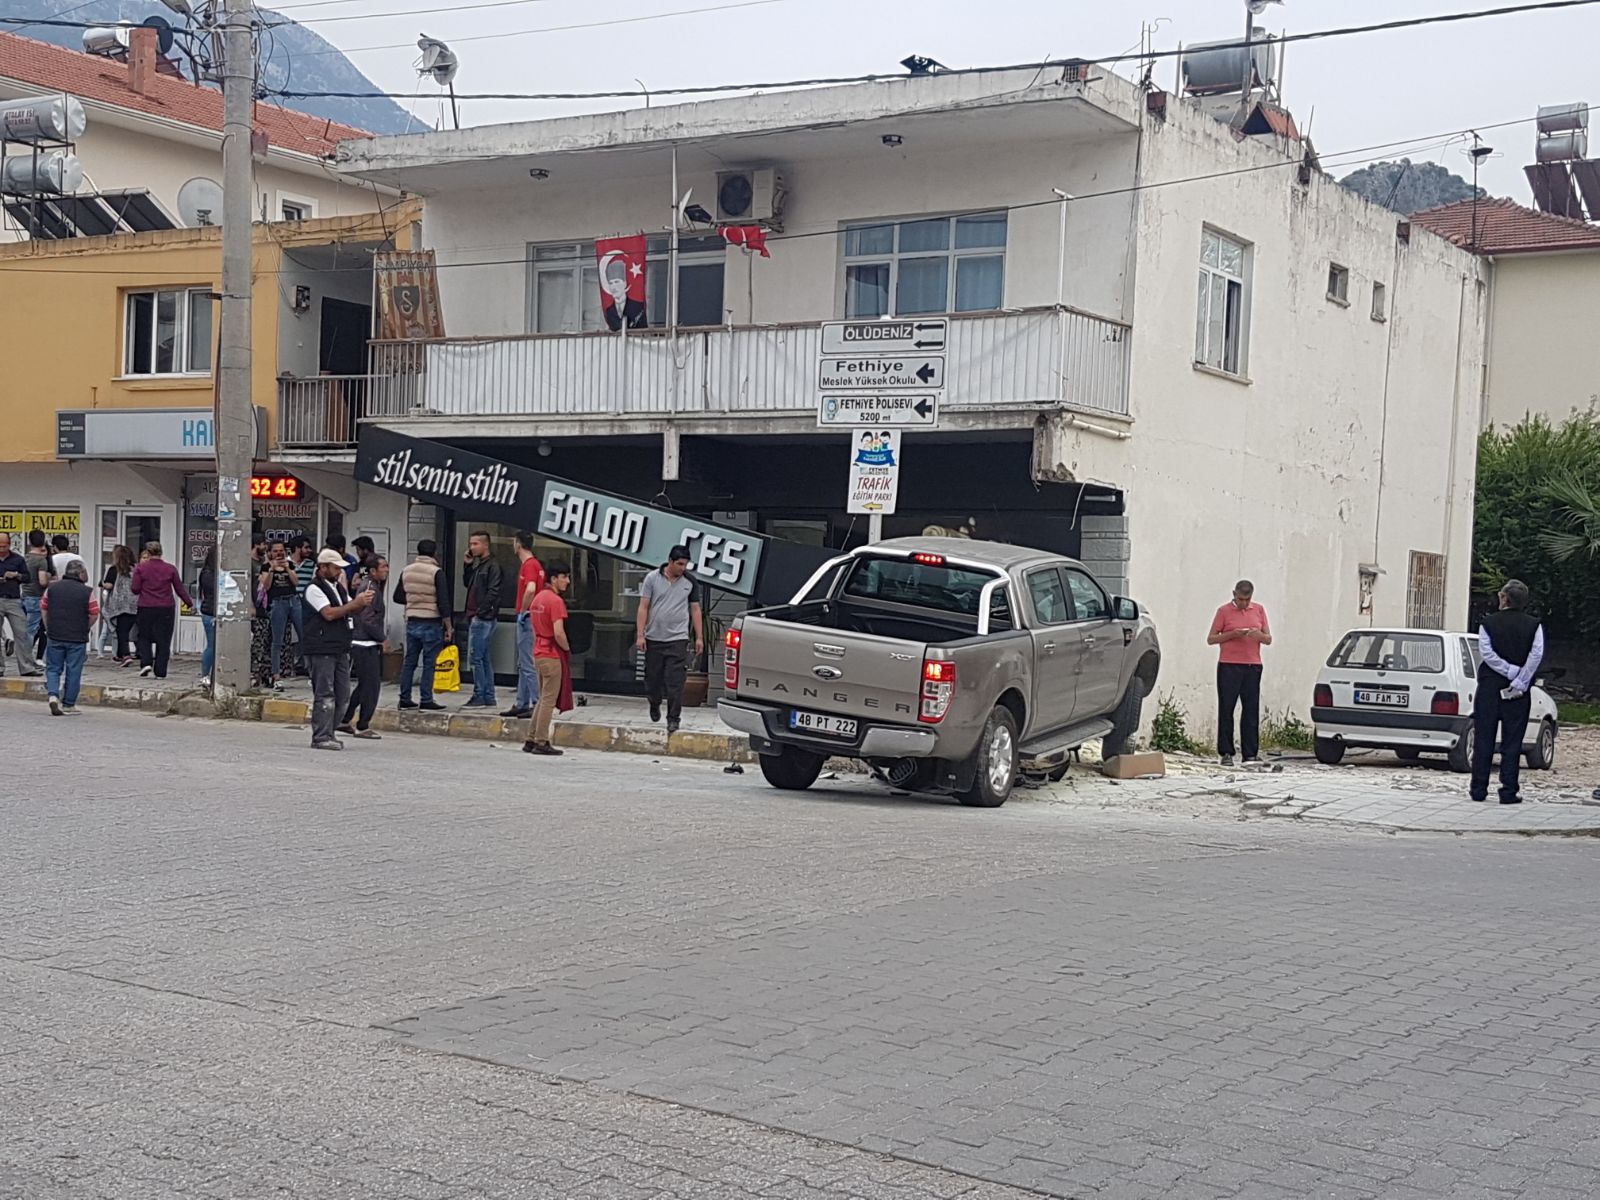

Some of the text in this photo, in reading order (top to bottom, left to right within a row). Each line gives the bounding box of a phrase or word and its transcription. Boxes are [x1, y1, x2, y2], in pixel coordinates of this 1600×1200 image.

[845, 325, 912, 339] ÖLÜDENİZ
[836, 360, 903, 374] Fethiye
[822, 375, 916, 386] Meslek Yüksek Okulu
[859, 412, 880, 421] 5200
[274, 478, 297, 496] 42
[857, 476, 892, 490] TRAFİK
[0, 515, 77, 530] EL EMLAK
[543, 490, 647, 554] SALON
[745, 677, 911, 713] RANGER
[1375, 694, 1391, 702] FAM
[1396, 695, 1407, 704] 35
[798, 714, 811, 726] 48
[816, 719, 830, 730] PT
[835, 722, 856, 734] 222
